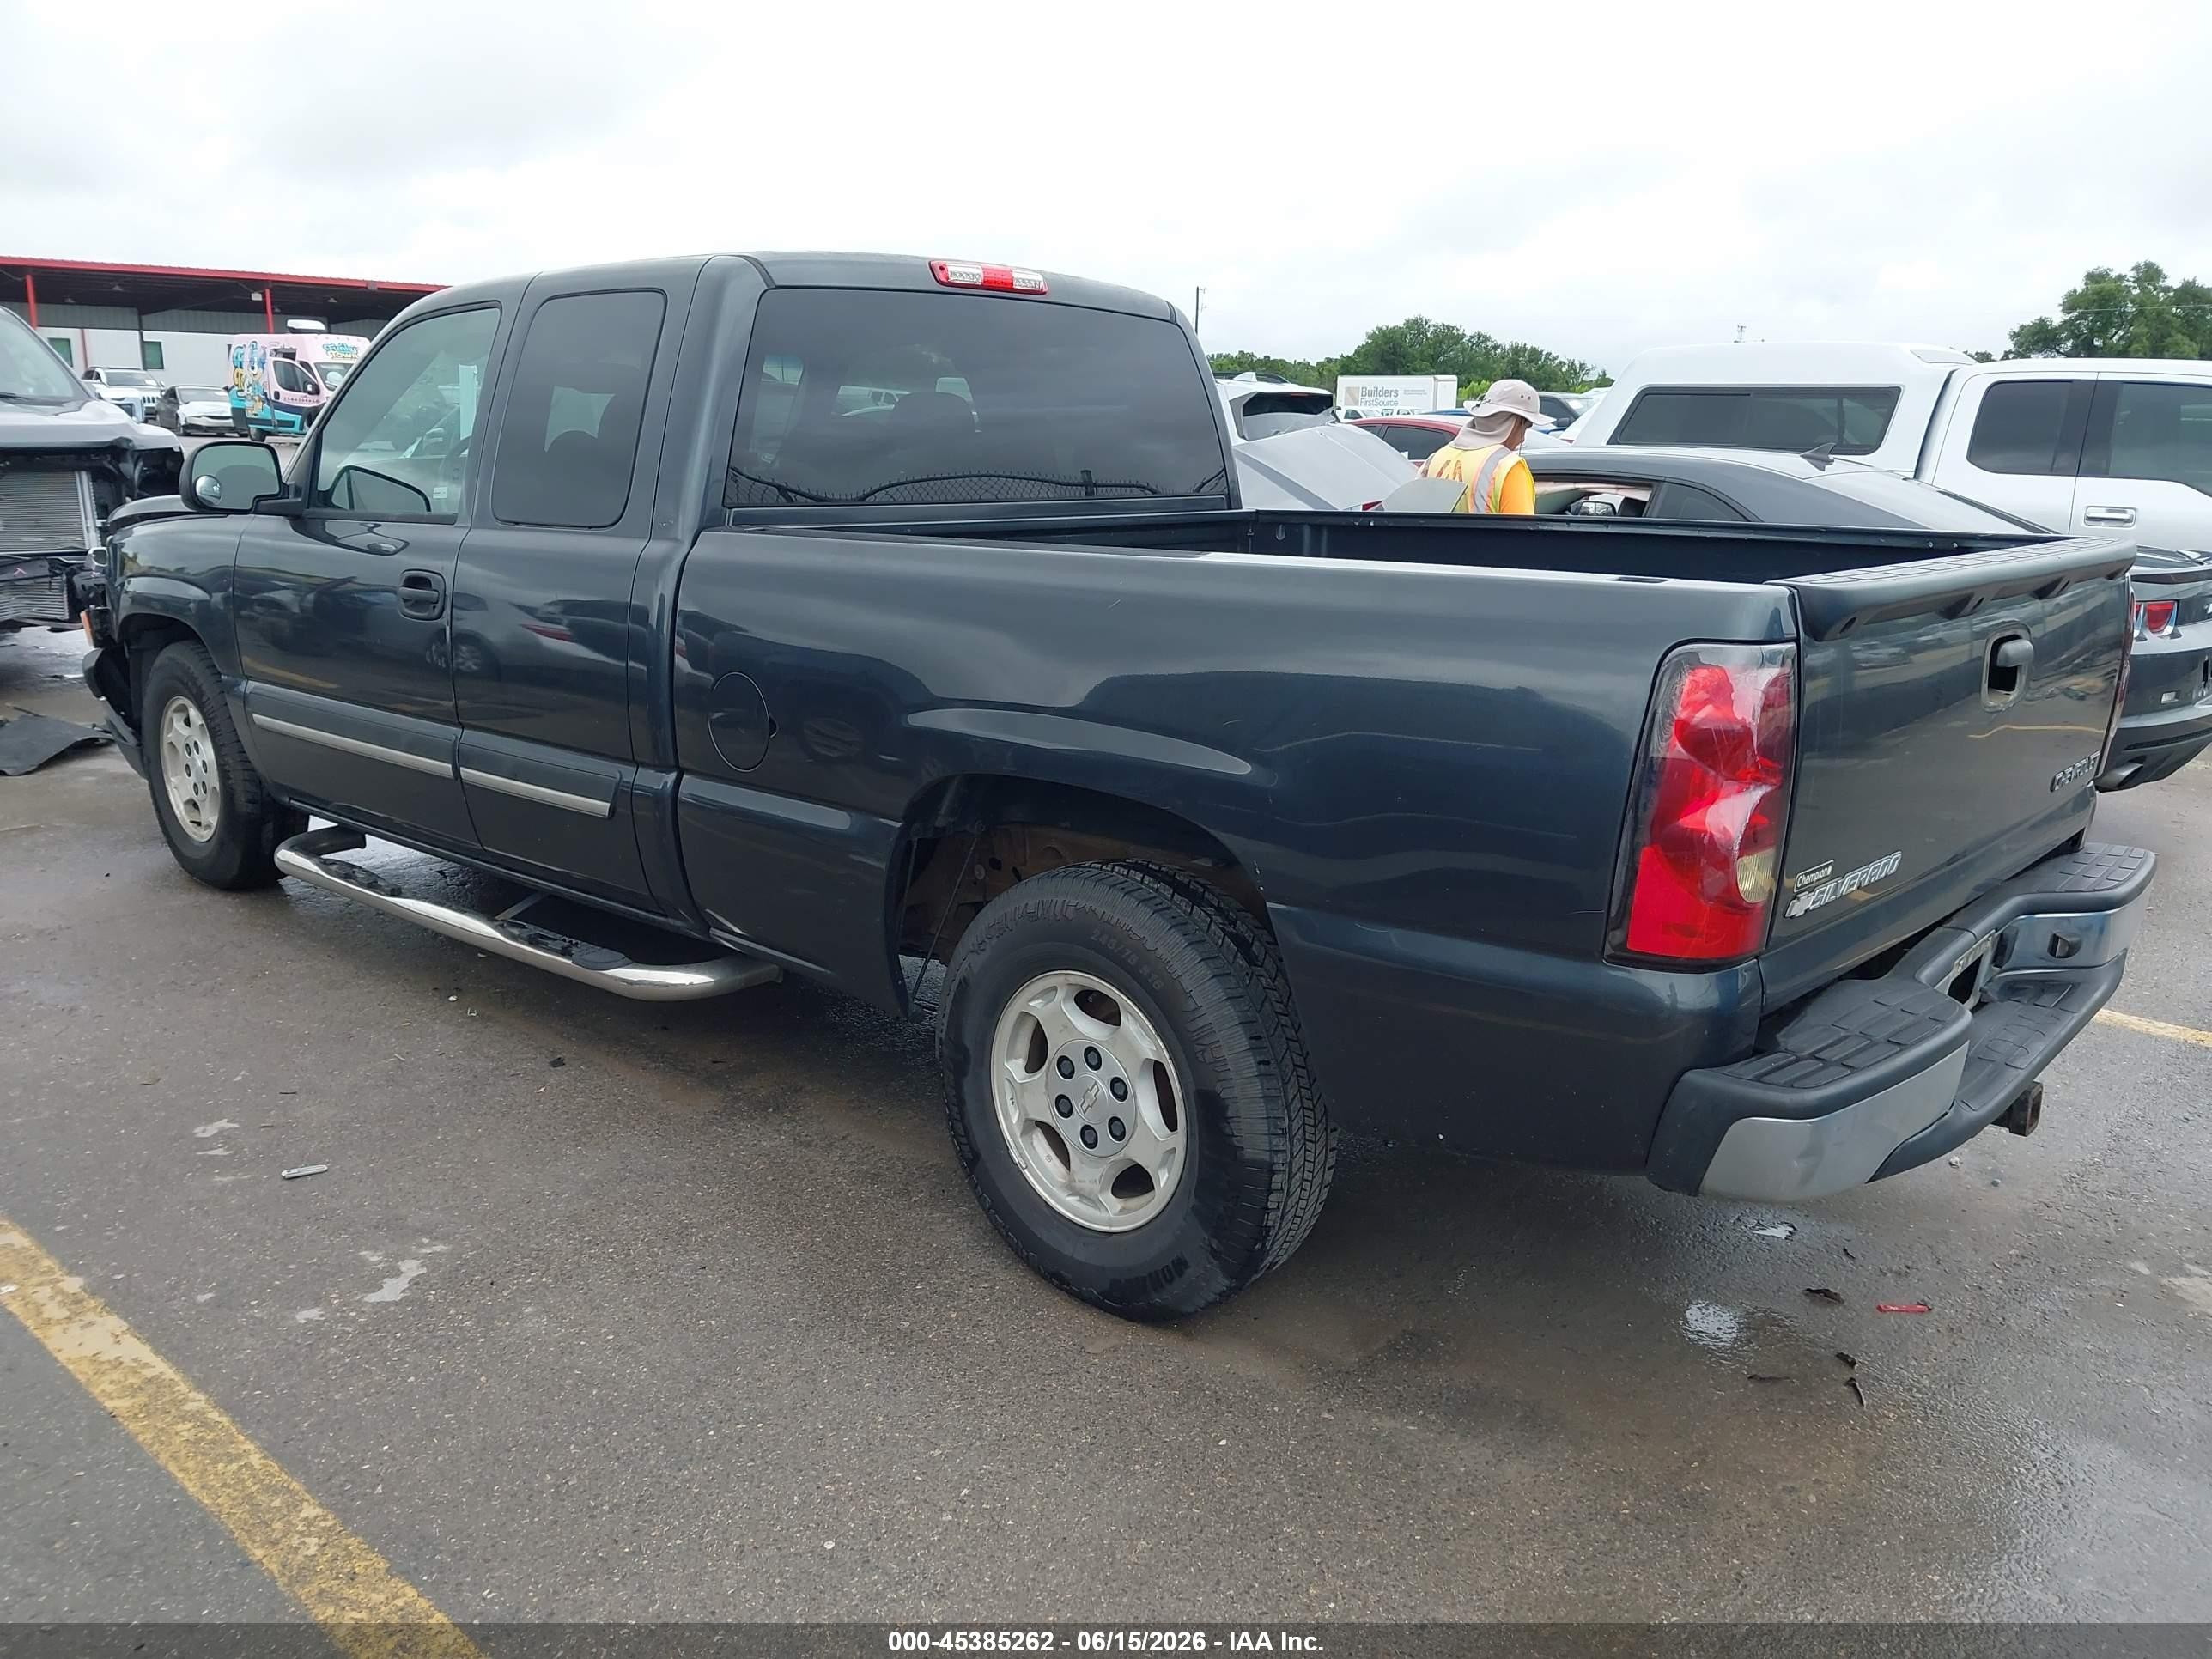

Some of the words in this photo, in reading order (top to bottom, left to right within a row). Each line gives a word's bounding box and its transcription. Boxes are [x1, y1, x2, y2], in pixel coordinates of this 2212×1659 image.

[1361, 386, 1399, 398] Builders
[1360, 398, 1399, 407] FirstSource
[1809, 851, 1902, 910] SILVERADO
